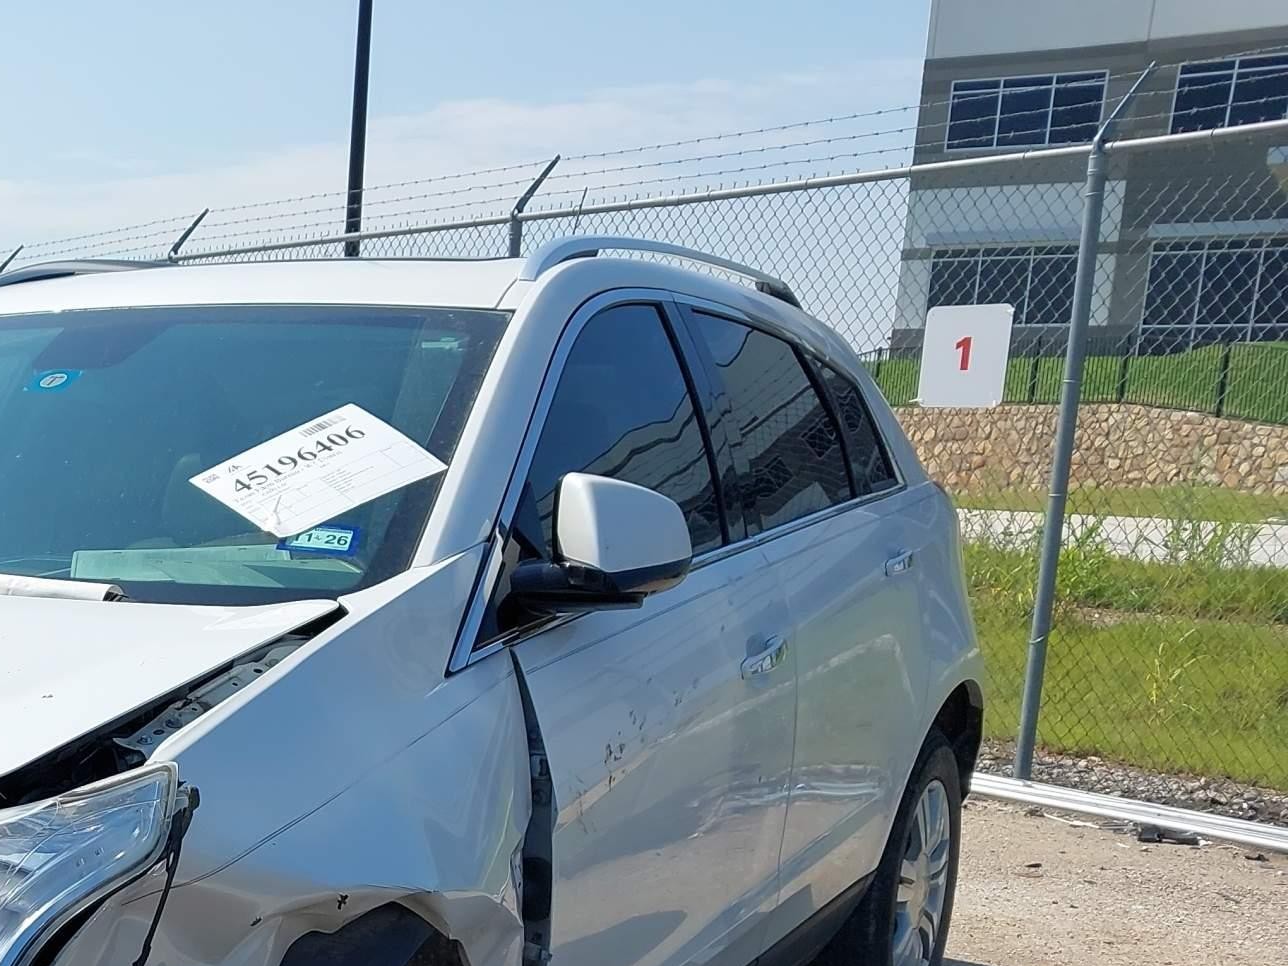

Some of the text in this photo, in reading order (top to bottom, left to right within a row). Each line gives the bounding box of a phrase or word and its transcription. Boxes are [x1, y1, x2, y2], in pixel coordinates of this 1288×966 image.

[955, 336, 973, 371] 1
[234, 424, 366, 493] 45196406
[324, 534, 348, 547] 26
